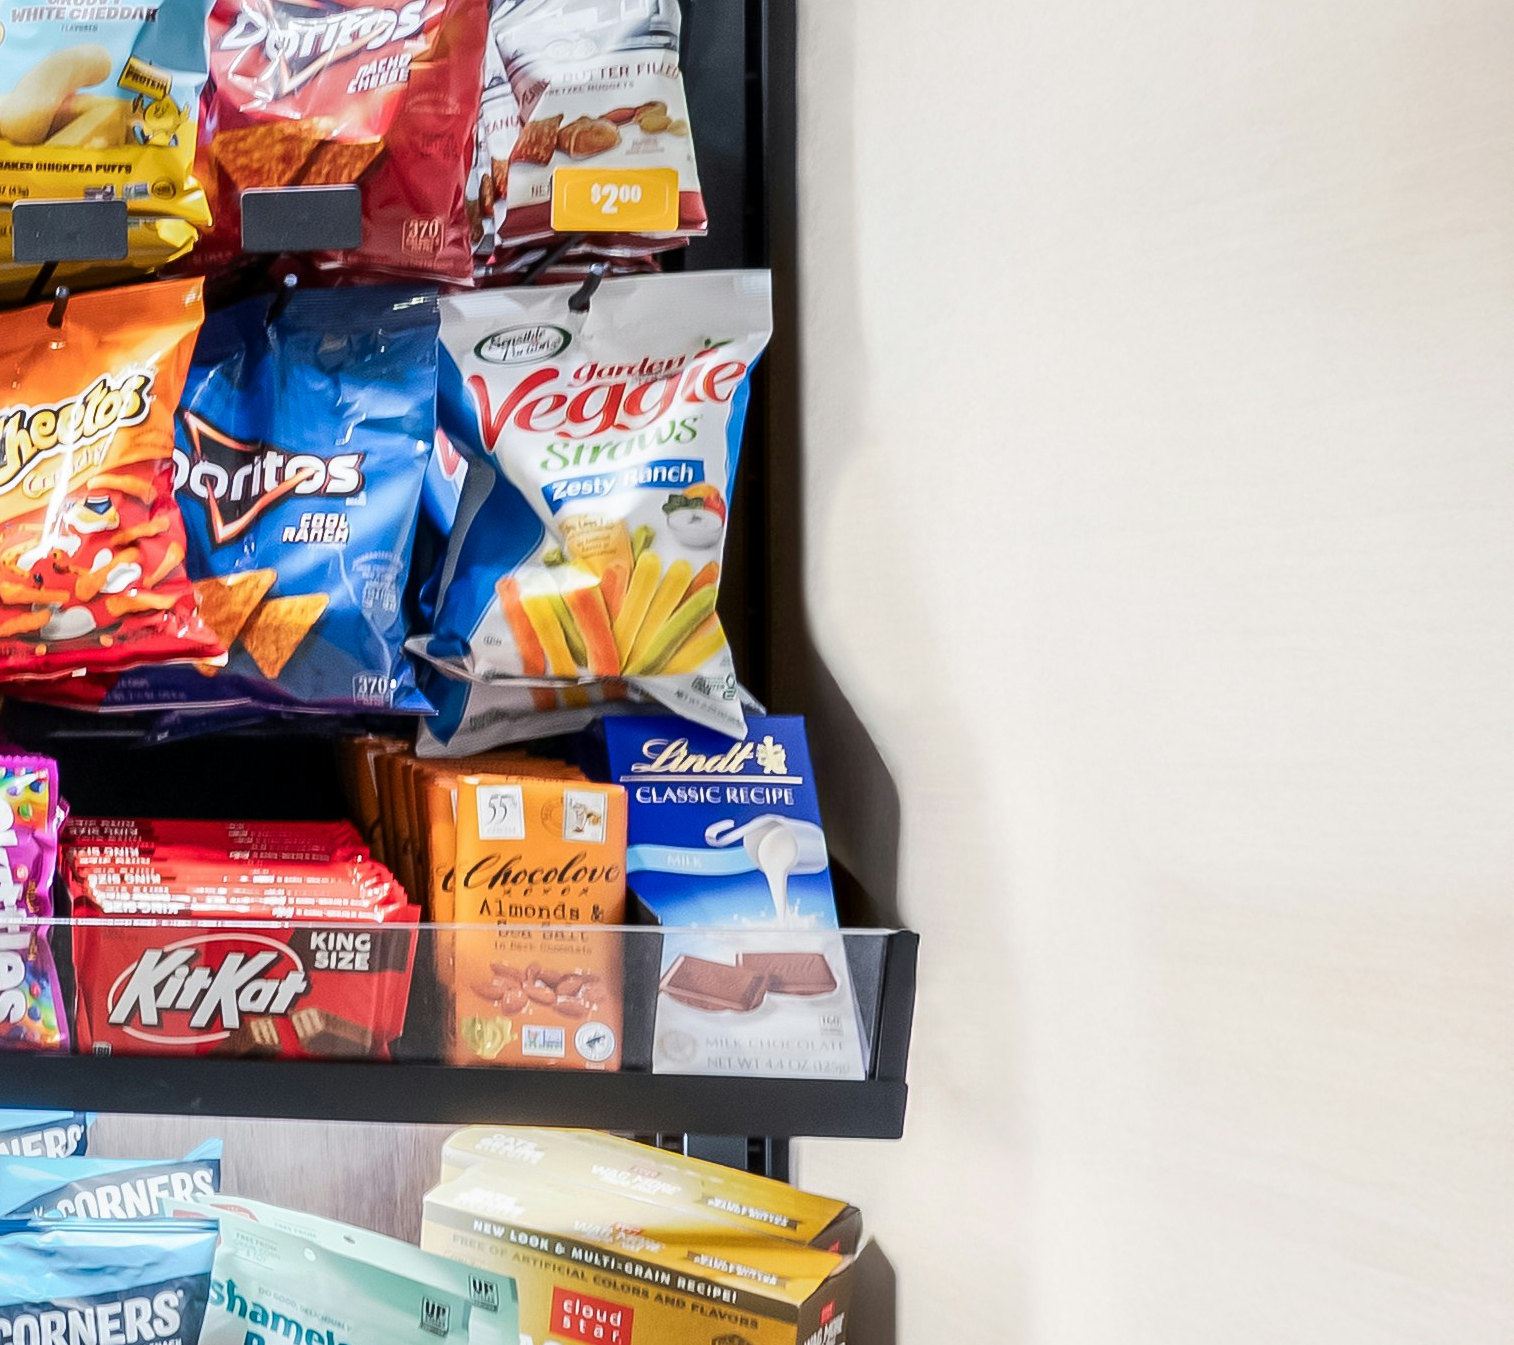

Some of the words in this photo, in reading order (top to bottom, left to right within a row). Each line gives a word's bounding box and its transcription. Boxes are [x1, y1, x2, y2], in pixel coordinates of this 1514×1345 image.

[11, 5, 65, 23] WHITE
[69, 4, 158, 22] CHEDDAR
[36, 161, 92, 174] CHICKPEA
[96, 161, 132, 174] PUFFS
[574, 355, 687, 383] garden
[468, 345, 746, 451] Veggie
[541, 417, 699, 473] Straws
[552, 475, 616, 501] Zesty
[623, 463, 694, 491] Ranch
[300, 513, 349, 530] COOL
[282, 526, 349, 543] RANCH
[631, 737, 754, 774] Lindt
[635, 786, 721, 805] CLASSIC
[726, 786, 794, 805] RECIPE
[463, 852, 621, 892] Chocolove
[667, 854, 702, 868] MILK
[479, 898, 580, 919] Almonds
[591, 905, 605, 923] &
[310, 931, 372, 951] KING
[314, 951, 371, 971] SIZE
[561, 1296, 623, 1328] cloud
[562, 1316, 622, 1345] star
